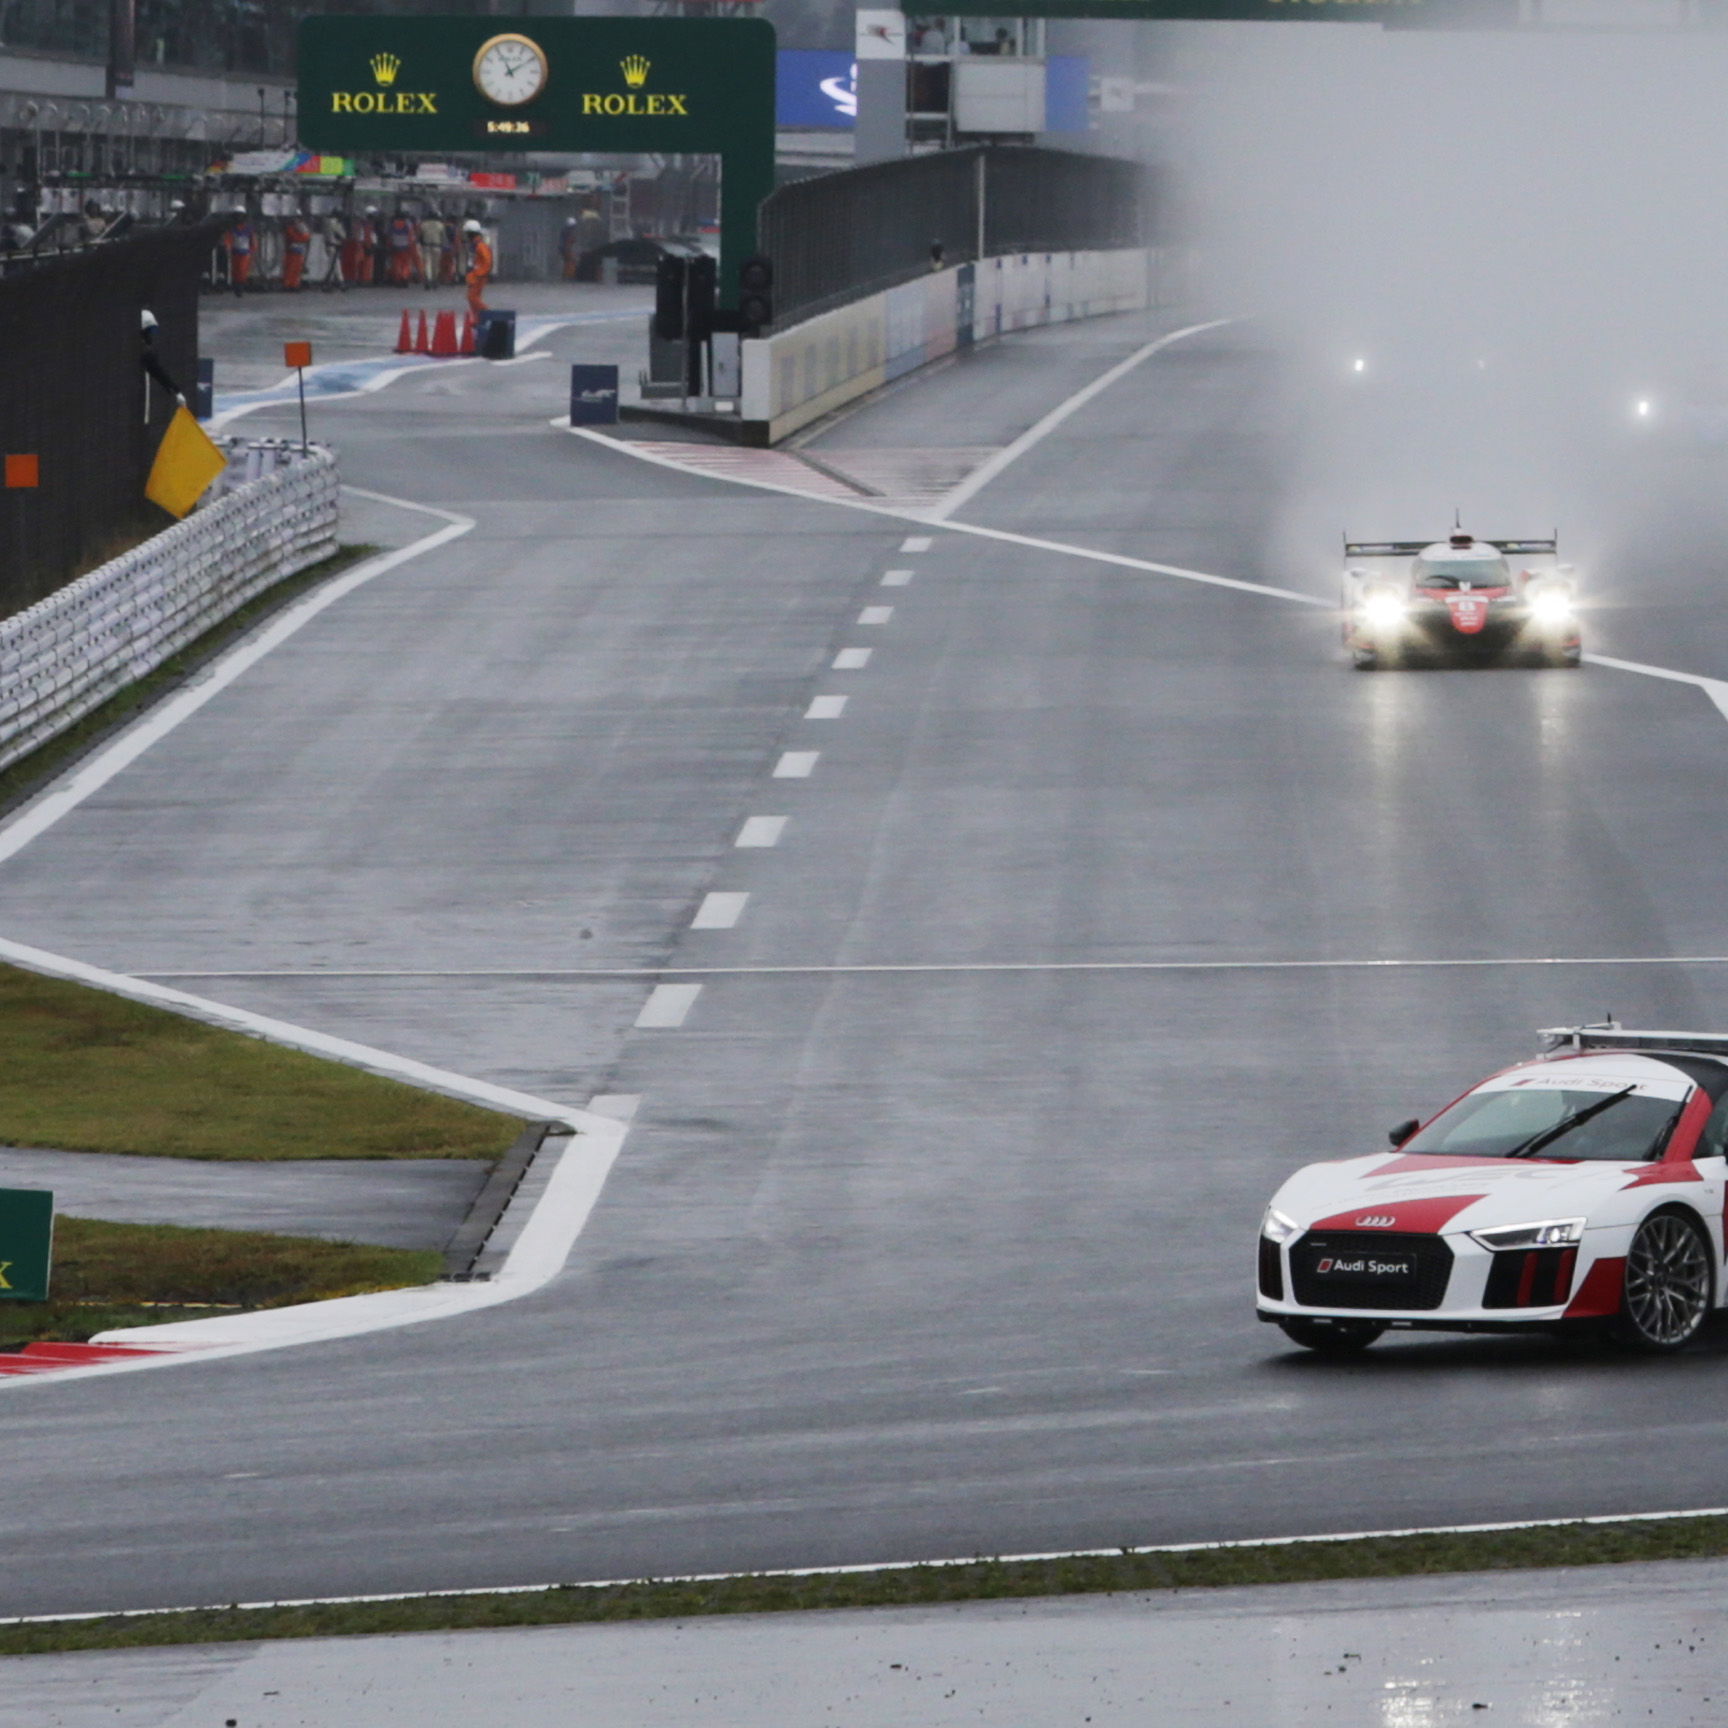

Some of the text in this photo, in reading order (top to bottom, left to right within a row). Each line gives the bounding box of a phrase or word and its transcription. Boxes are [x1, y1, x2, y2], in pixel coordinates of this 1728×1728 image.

[331, 92, 438, 114] ROLEX
[582, 94, 688, 116] ROLEX
[1334, 1259, 1409, 1275] Audi Sport
